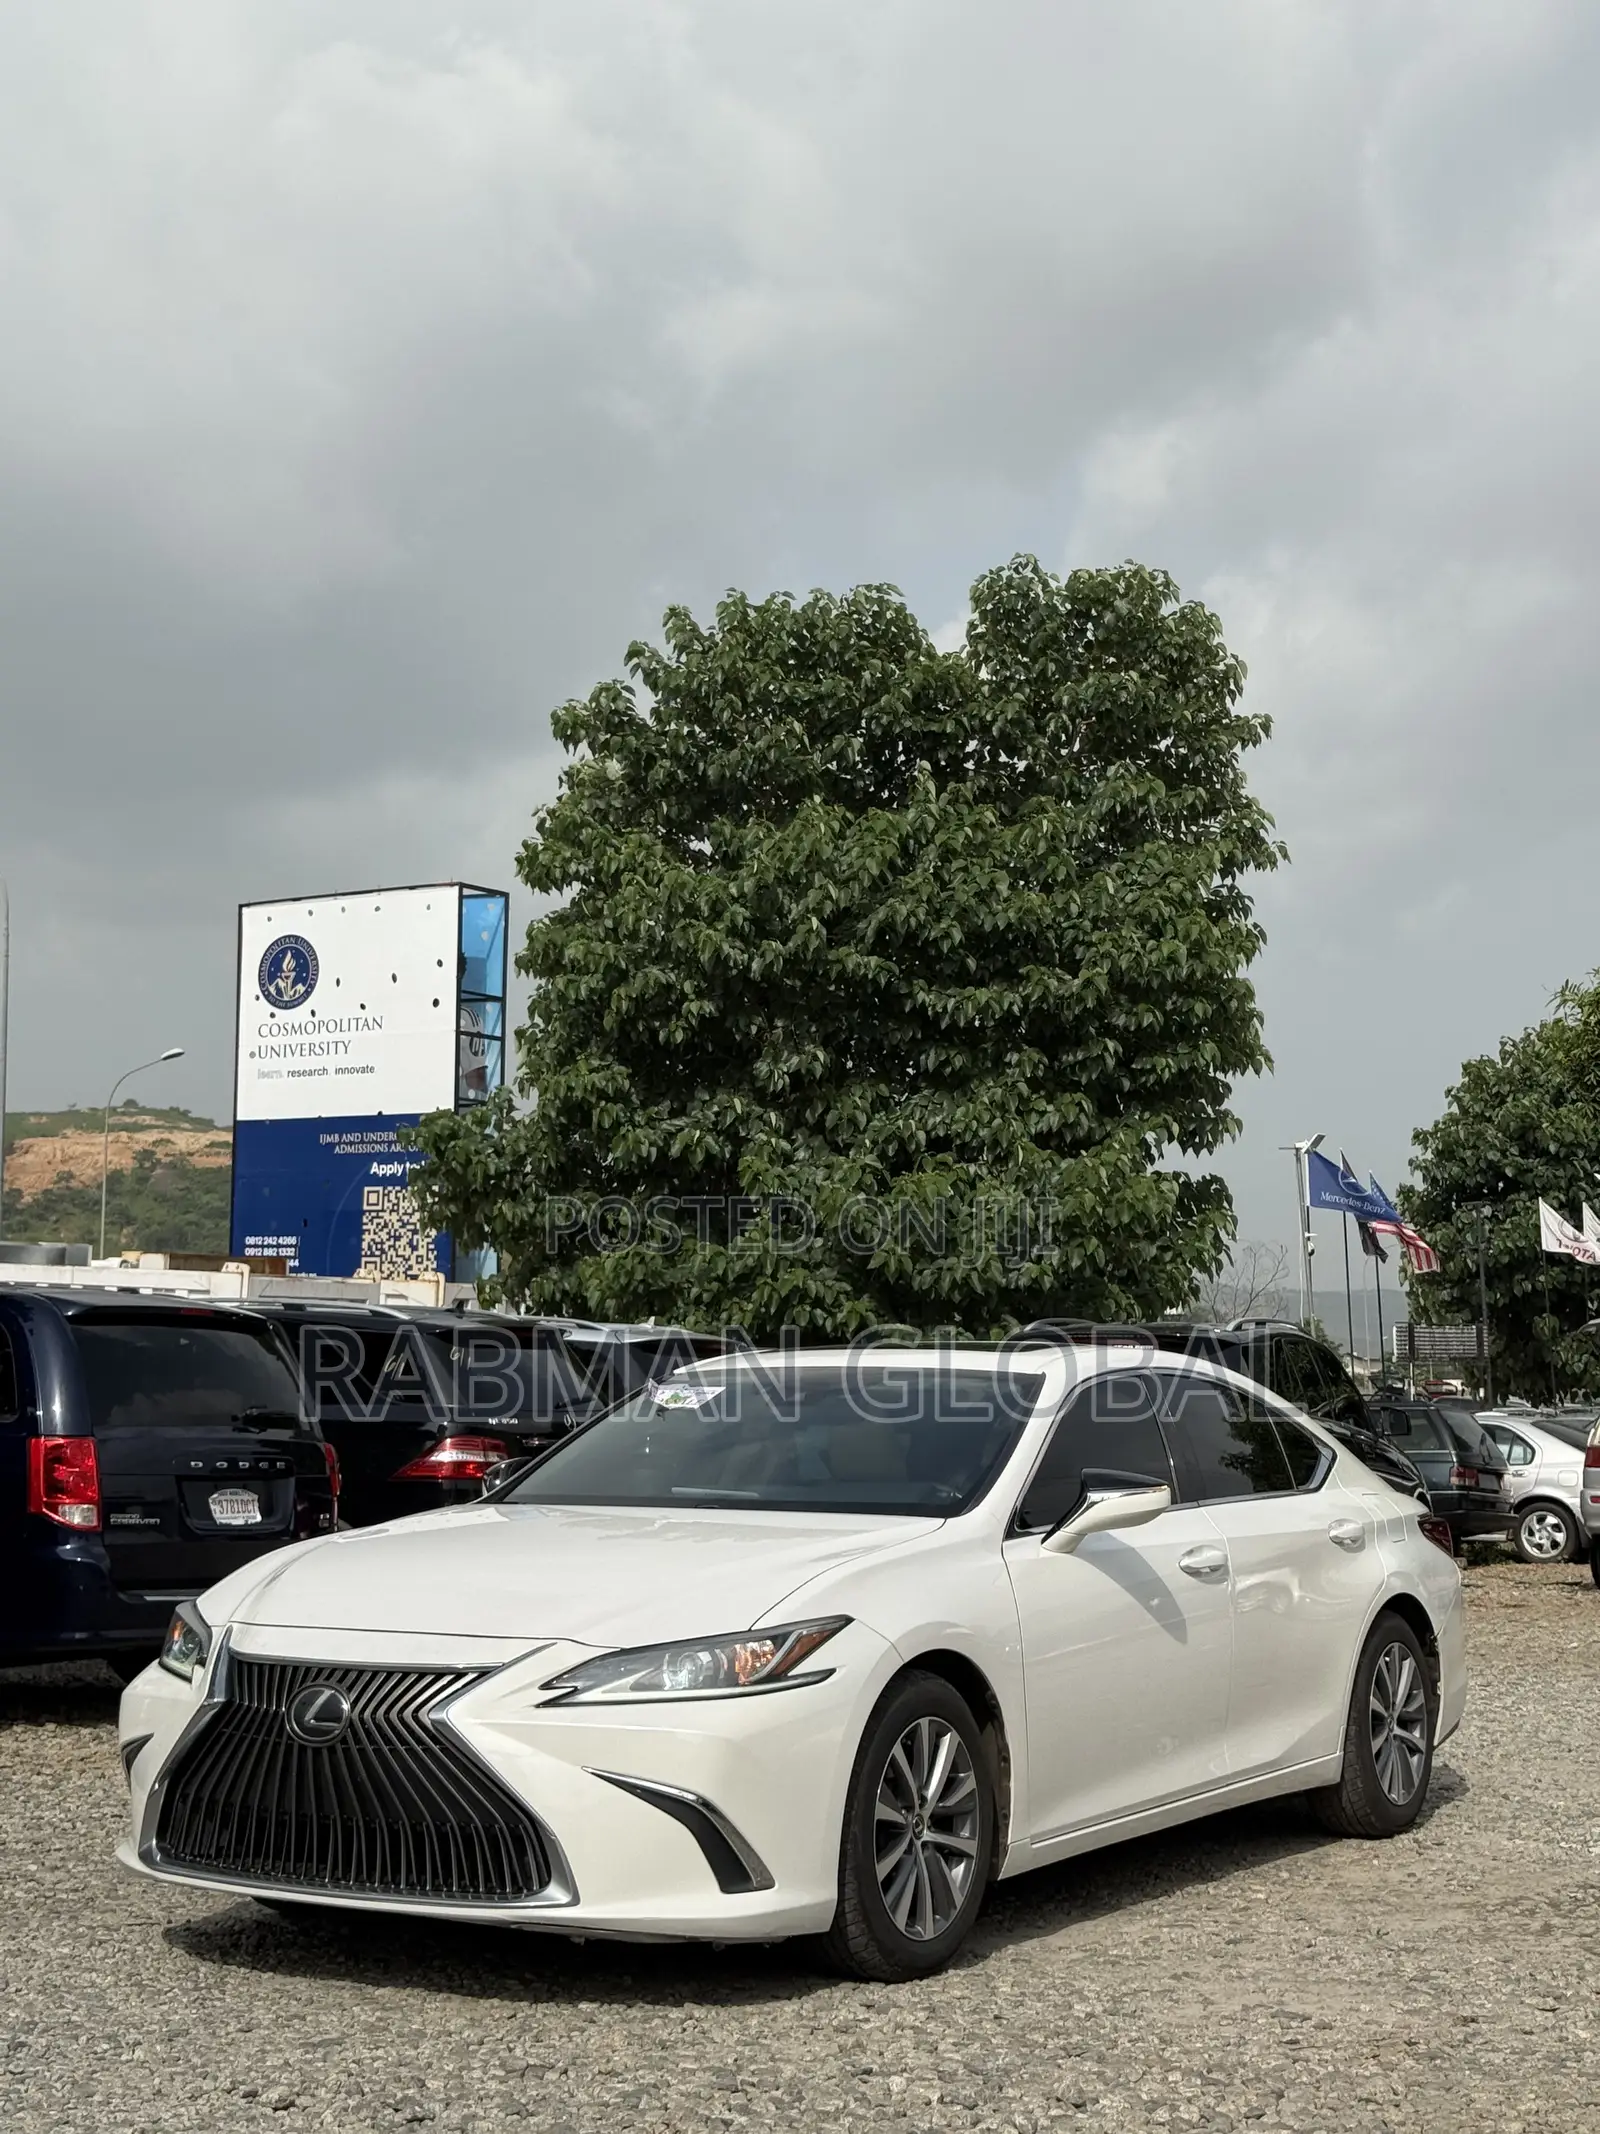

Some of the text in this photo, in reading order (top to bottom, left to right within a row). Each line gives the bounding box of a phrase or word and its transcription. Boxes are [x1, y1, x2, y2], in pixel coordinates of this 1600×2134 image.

[257, 1015, 384, 1038] COSMOPOLITAN
[257, 1040, 352, 1060] UNIVERSITY
[334, 1064, 376, 1075] innovate
[319, 1133, 340, 1145] IJMB
[341, 1132, 362, 1143] AND
[333, 1143, 389, 1154] ADMISSIONS
[369, 1161, 404, 1177] Apply
[1320, 1191, 1386, 1215] Mercedes-Benz
[190, 1460, 286, 1470] DODGE
